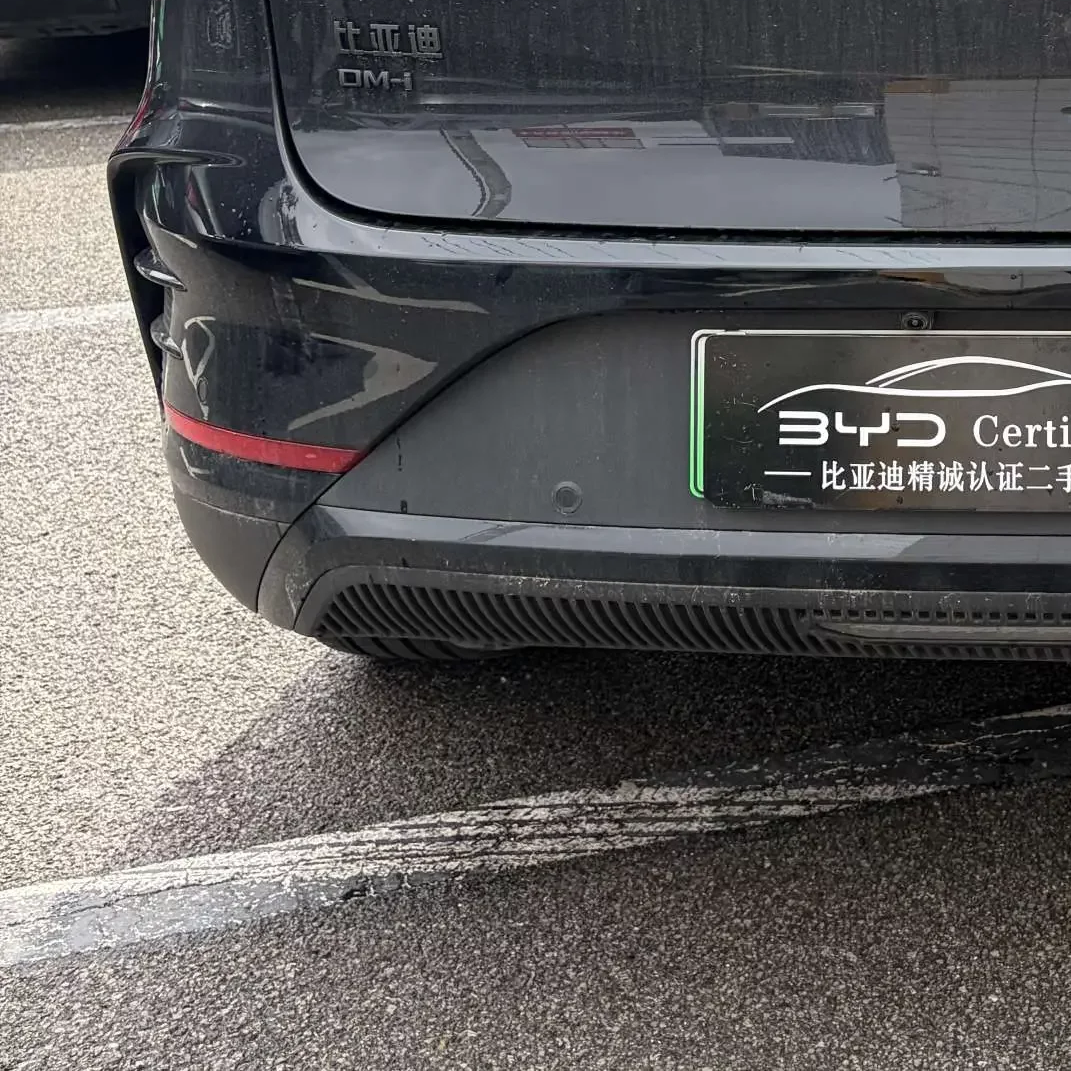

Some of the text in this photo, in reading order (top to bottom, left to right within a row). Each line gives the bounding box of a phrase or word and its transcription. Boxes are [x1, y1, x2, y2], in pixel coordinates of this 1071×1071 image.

[333, 20, 443, 59] 比亚迪
[337, 68, 413, 91] DM-i
[778, 410, 946, 447] BYD
